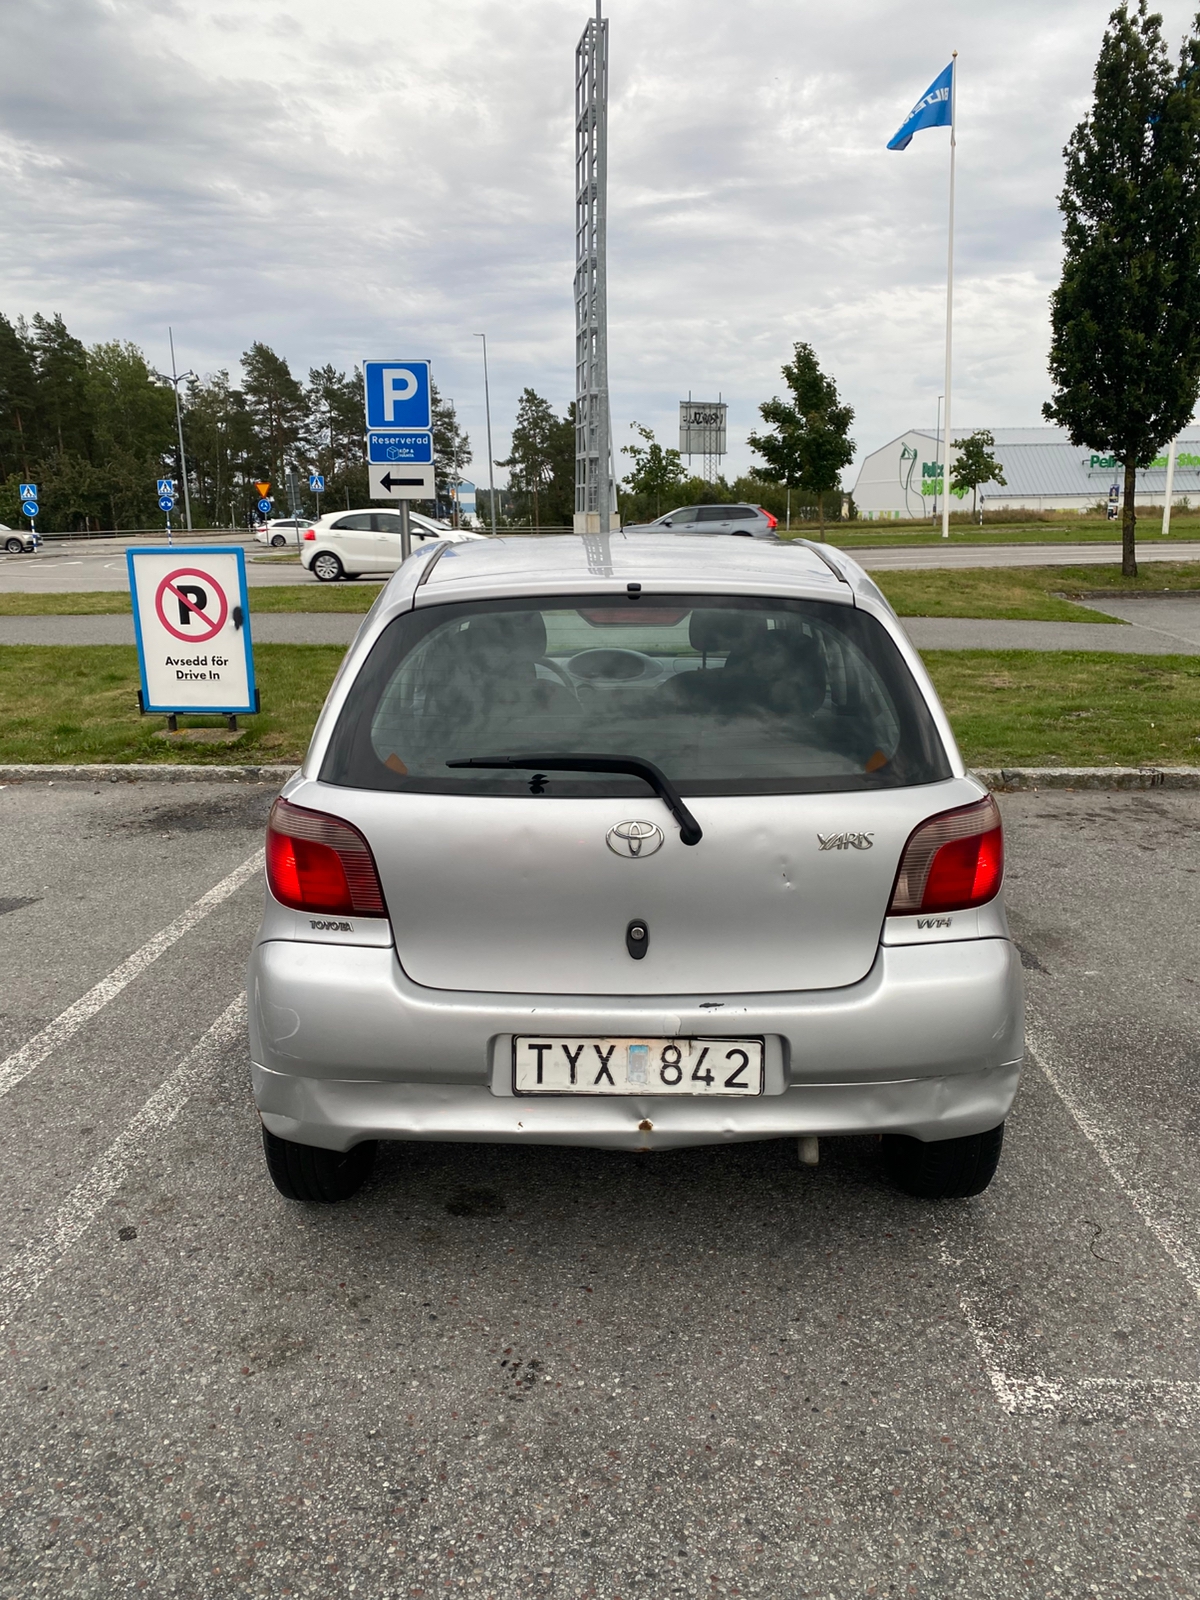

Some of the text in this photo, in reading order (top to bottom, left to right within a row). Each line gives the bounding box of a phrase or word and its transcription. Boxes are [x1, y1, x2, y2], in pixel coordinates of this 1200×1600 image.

[382, 368, 419, 422] P
[371, 435, 429, 445] Reserverad
[165, 655, 229, 667] Avsedd för
[176, 669, 221, 680] Drive In
[309, 919, 355, 933] TOYOTA
[528, 1043, 750, 1089] TYX 842
